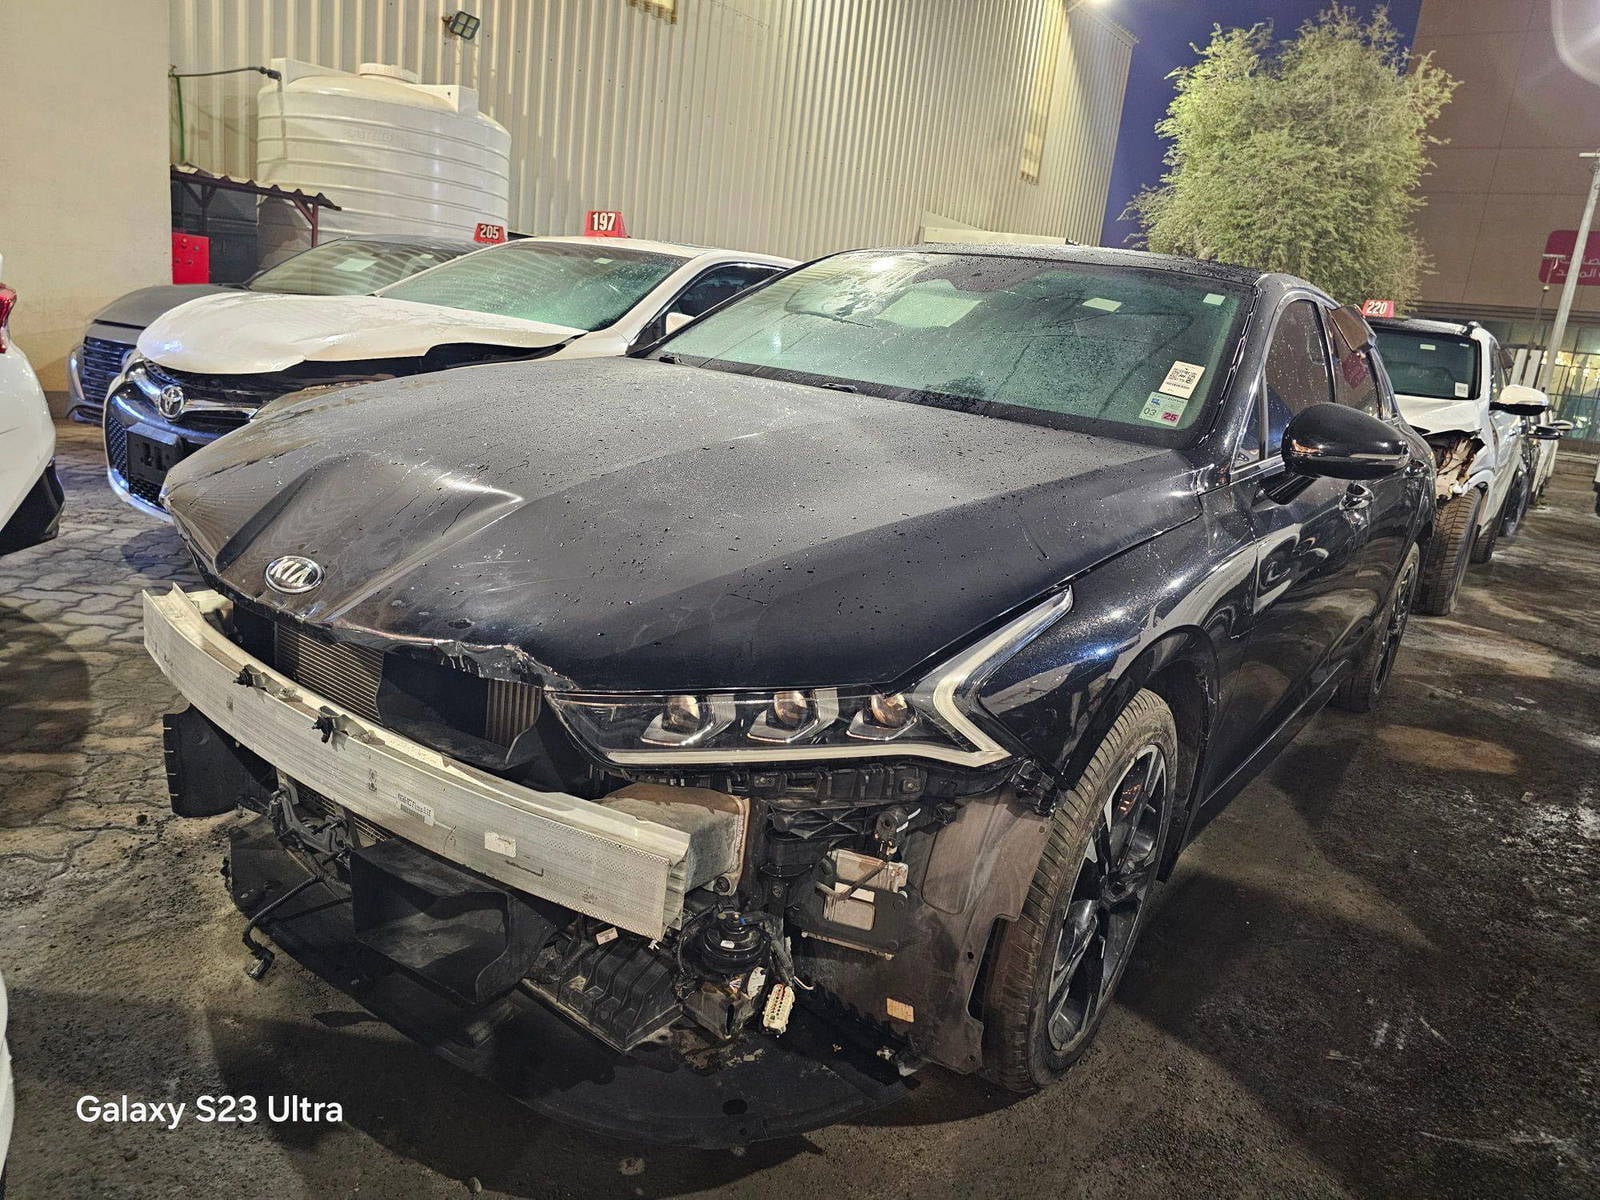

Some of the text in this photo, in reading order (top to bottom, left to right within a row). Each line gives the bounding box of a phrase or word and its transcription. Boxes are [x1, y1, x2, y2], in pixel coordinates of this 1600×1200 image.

[592, 212, 616, 231] 197
[479, 224, 499, 240] 205
[1366, 301, 1388, 315] 220
[1143, 407, 1157, 416] 03
[1162, 412, 1179, 422] 25
[269, 559, 312, 587] KIA
